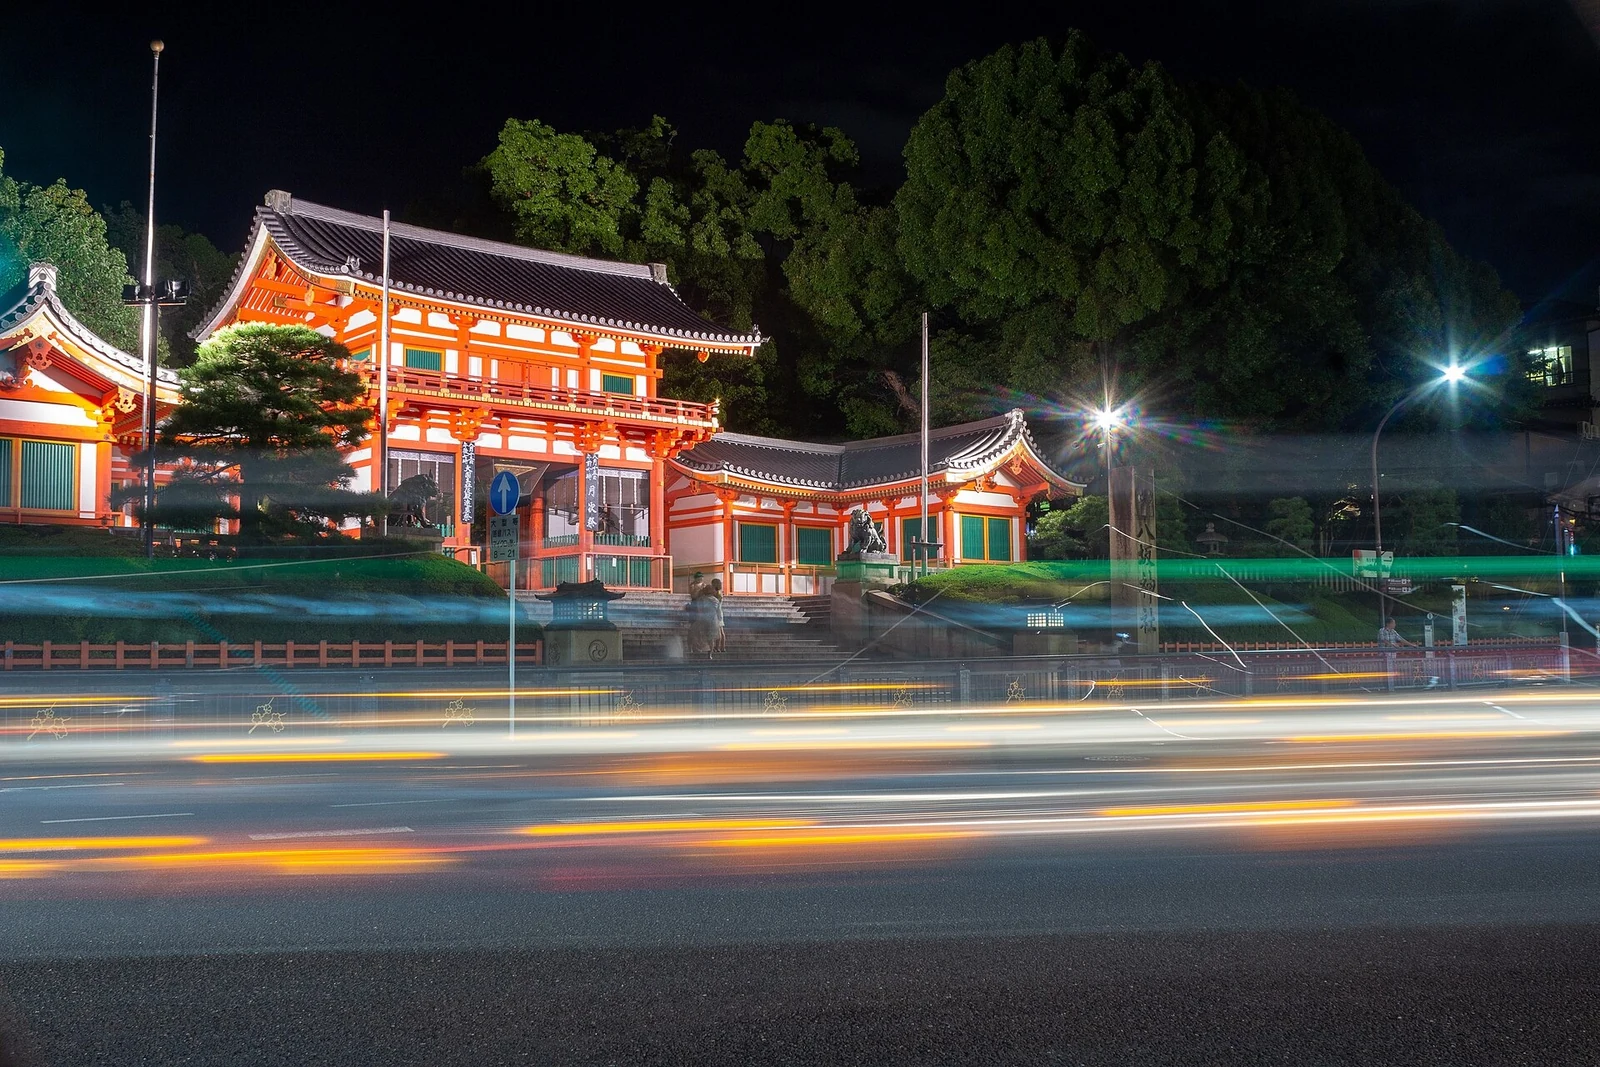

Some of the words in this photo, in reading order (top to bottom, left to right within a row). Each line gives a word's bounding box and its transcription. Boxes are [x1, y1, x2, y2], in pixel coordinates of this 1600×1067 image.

[586, 484, 597, 529] 月次祭
[1136, 522, 1157, 635] 八坂神社
